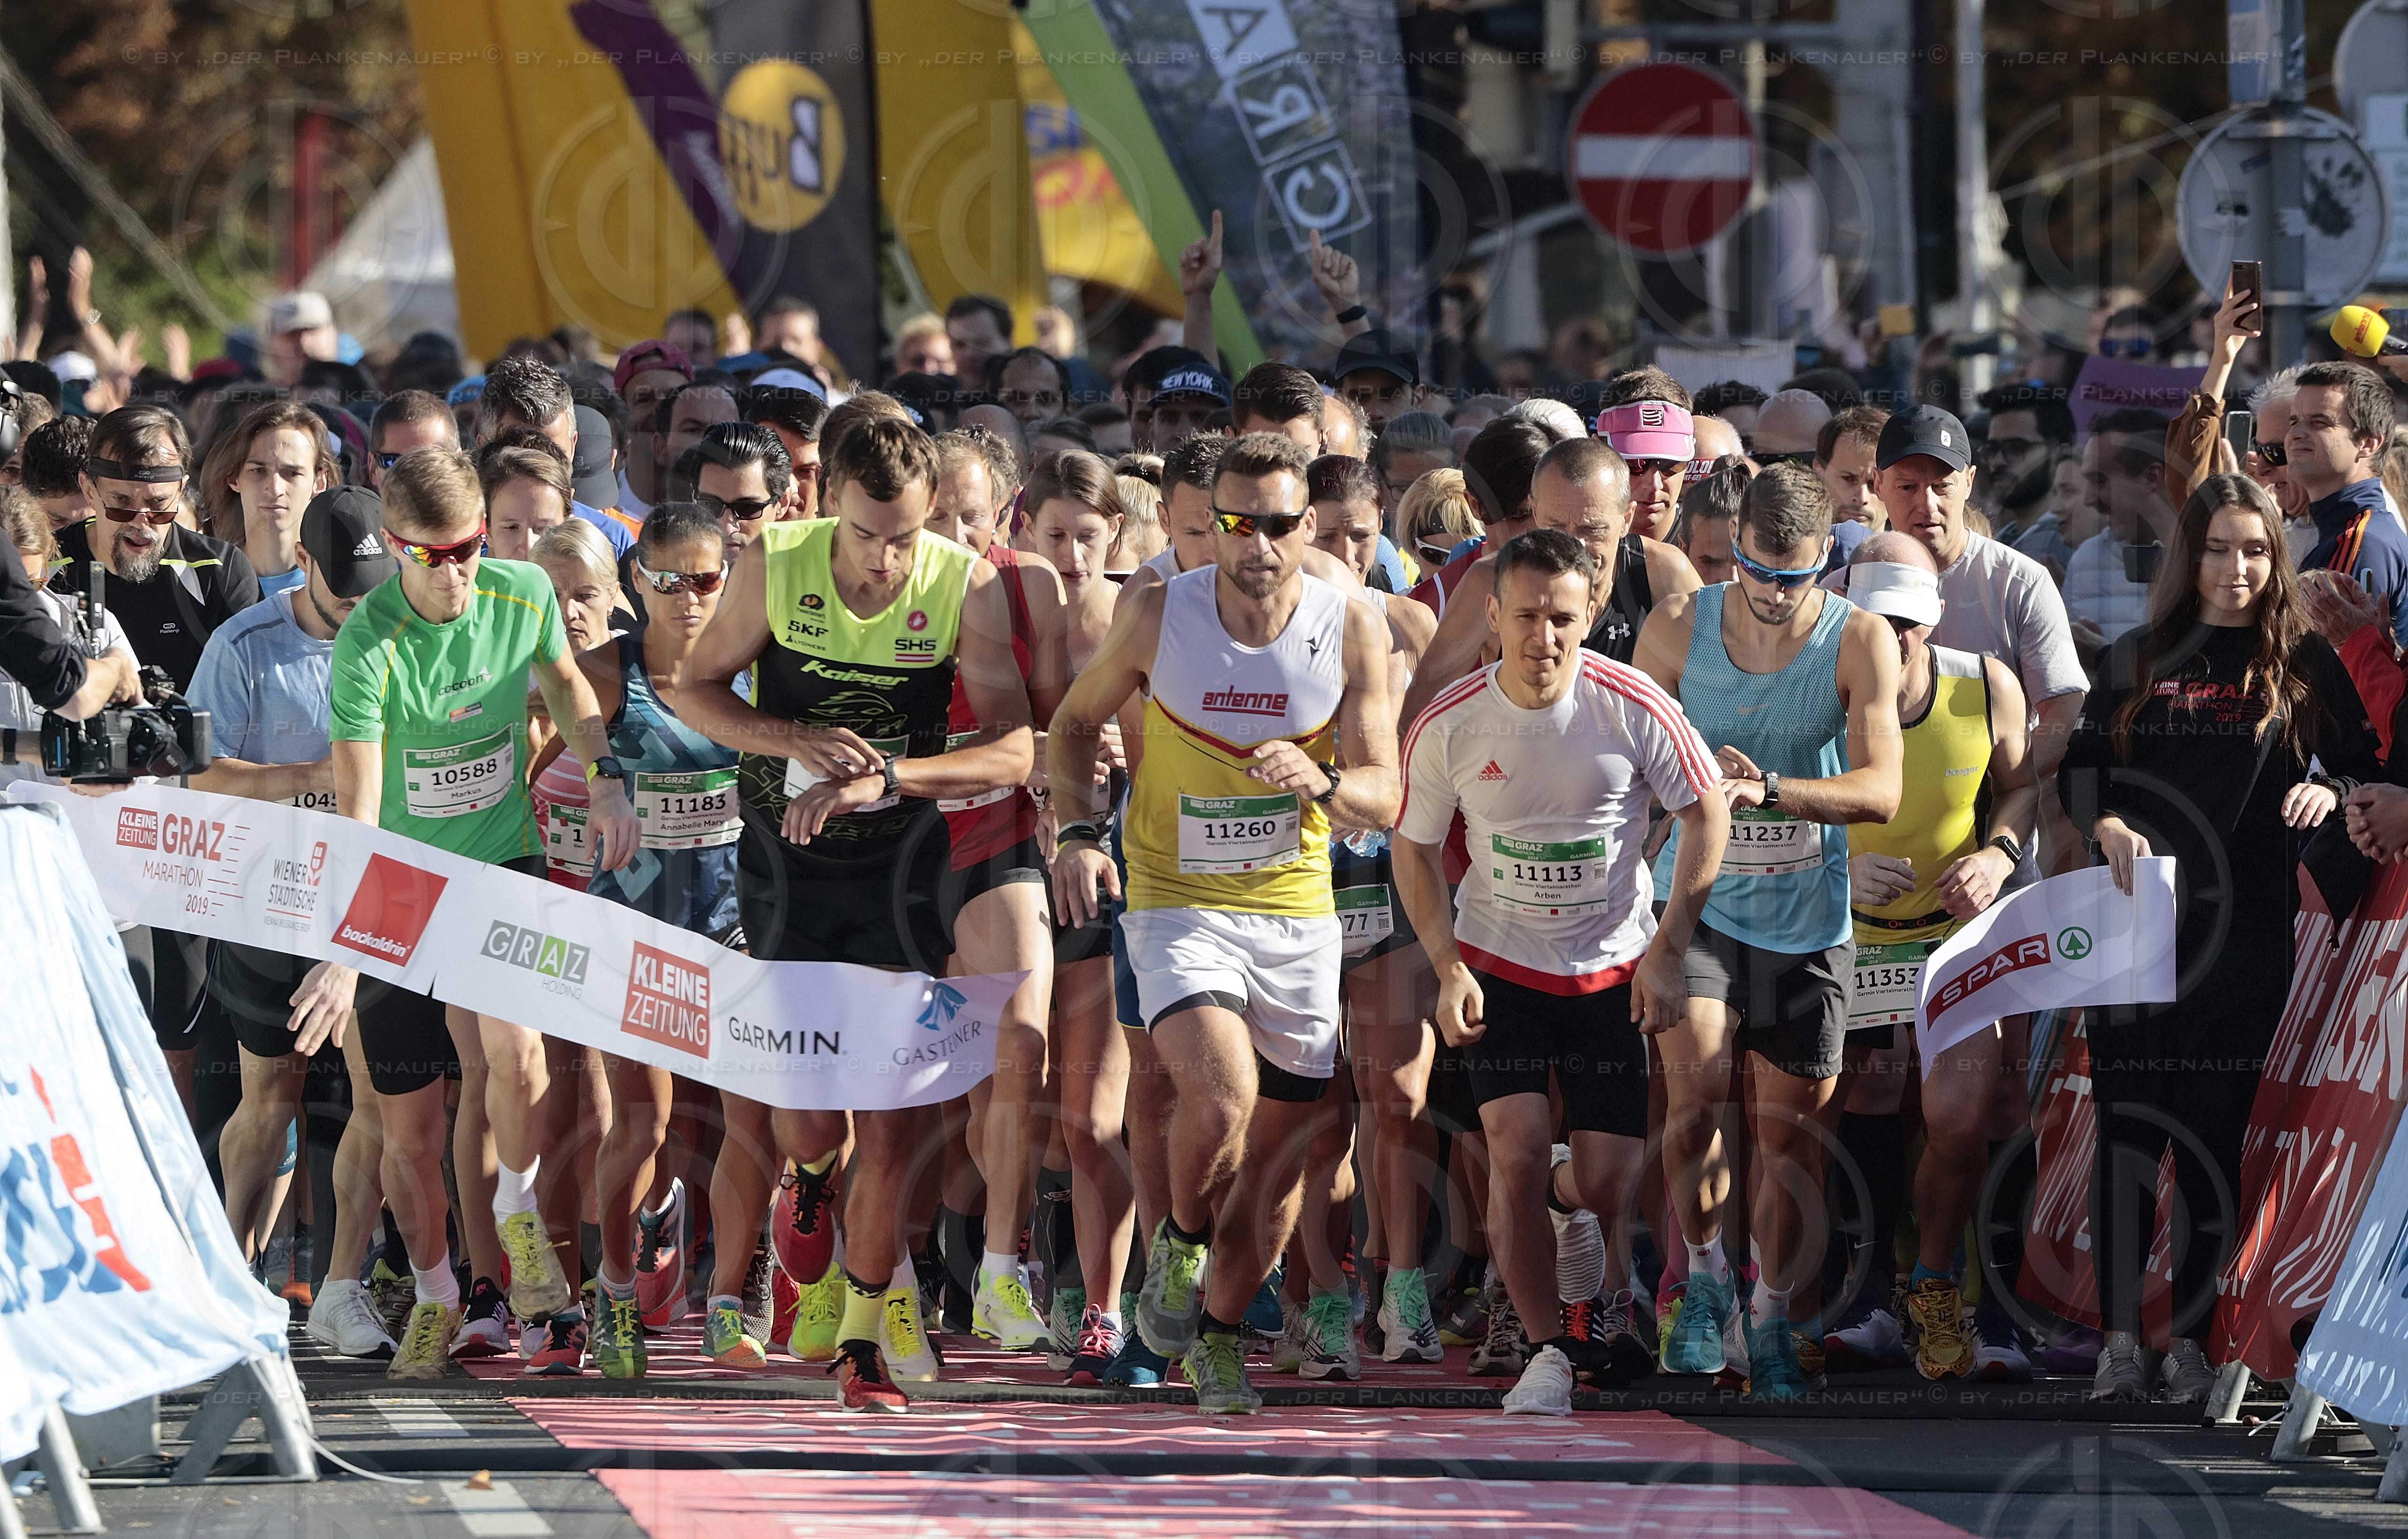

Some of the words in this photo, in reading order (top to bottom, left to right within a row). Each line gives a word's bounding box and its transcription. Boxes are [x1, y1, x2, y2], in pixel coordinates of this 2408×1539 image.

[1185, 371, 1213, 391] YORK
[353, 547, 384, 556] adidas
[788, 619, 829, 637] SKF
[895, 638, 937, 651] SHS
[800, 659, 910, 686] Kaiser
[438, 674, 484, 696] cocoon
[2185, 681, 2256, 699] GRAZ
[1202, 684, 1289, 710] antenne
[431, 758, 497, 786] 10588
[663, 776, 692, 785] GRAZ
[1478, 773, 1508, 781] adidas
[451, 787, 482, 799] Markus
[660, 793, 727, 814] 11183
[1205, 800, 1235, 809] GRAZ
[120, 810, 158, 830] KLEINE
[660, 822, 702, 831] Annabelle
[1204, 821, 1276, 839] 11260
[118, 827, 157, 845] ZEITUNG
[162, 813, 225, 862] GRAZ
[1730, 824, 1797, 842] 11237
[1514, 842, 1544, 852] GRAZ
[142, 860, 203, 888] MARATHON
[273, 858, 308, 885] WIENER
[1513, 864, 1582, 883] 11113
[185, 894, 209, 915] 2019
[268, 883, 317, 912] STÄDTISCHE
[1534, 890, 1561, 899] Arben
[340, 924, 407, 958] backaldrin
[1857, 945, 1882, 956] GRAZ
[487, 927, 586, 980] GRAZ
[632, 953, 708, 1009] KLEINE
[1854, 967, 1920, 989] 11353
[1941, 939, 2047, 1007] SPAR
[540, 979, 582, 1000] HOLDING
[1875, 986, 1915, 995] Viertelmarath
[627, 990, 707, 1047] ZEITUNG
[729, 1016, 840, 1055] GARMIN
[892, 1020, 982, 1066] GASTEINER
